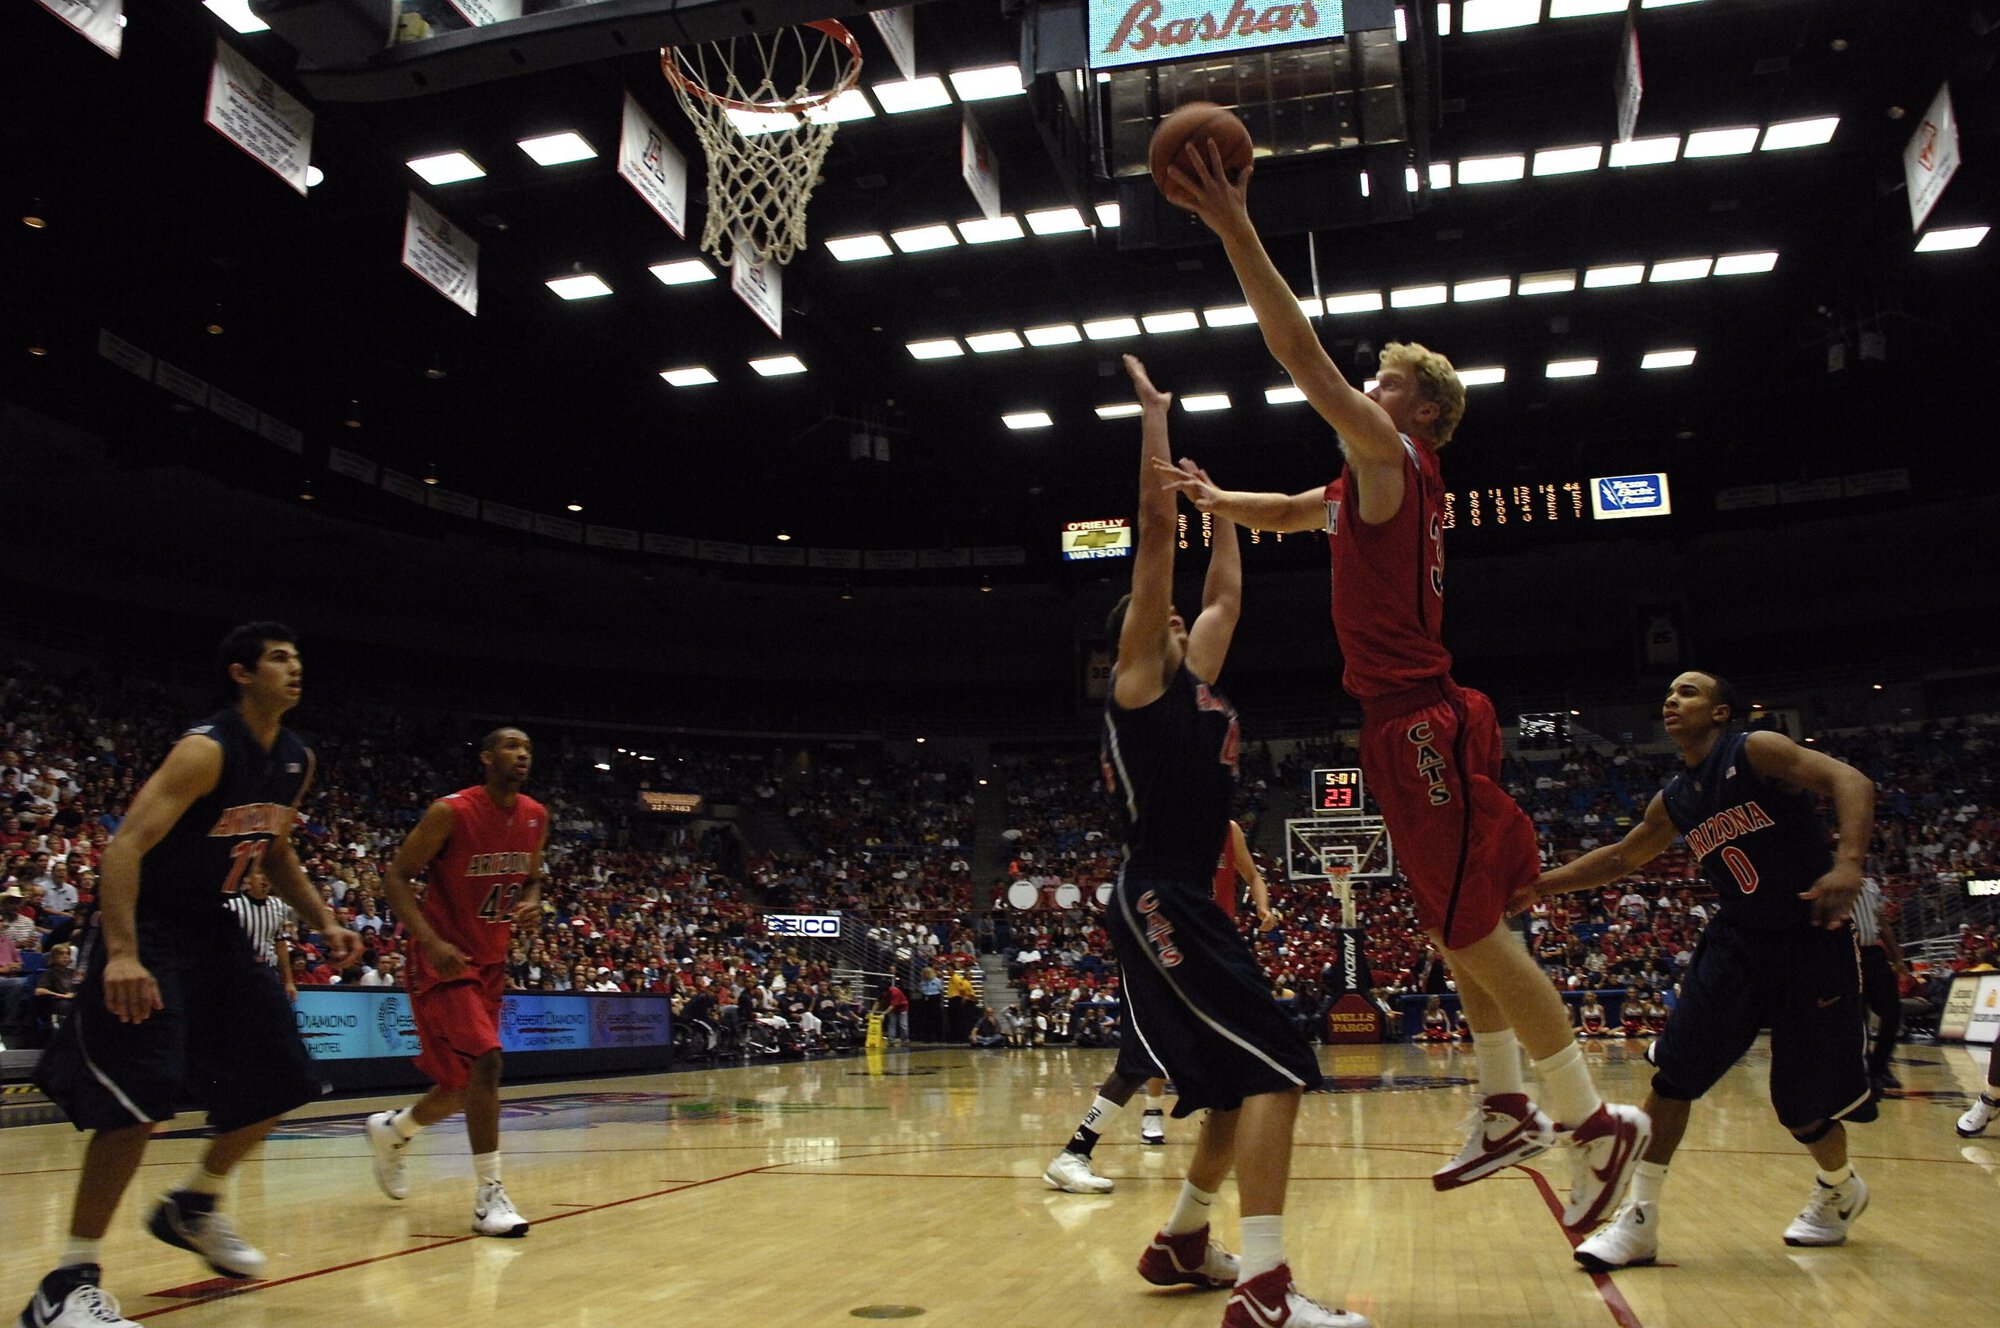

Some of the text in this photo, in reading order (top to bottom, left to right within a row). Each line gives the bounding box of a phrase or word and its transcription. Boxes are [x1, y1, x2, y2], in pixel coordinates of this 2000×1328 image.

[1067, 519, 1124, 531] O'RIELLY
[1068, 548, 1127, 560] WATSON
[1408, 721, 1451, 806] CATS
[1324, 788, 1352, 807] 23
[1721, 846, 1759, 894] 0
[1136, 889, 1184, 968] CATS
[1344, 932, 1357, 989] ARIZONA
[1330, 1013, 1375, 1022] WELLS
[1333, 1023, 1375, 1032] FARGO
